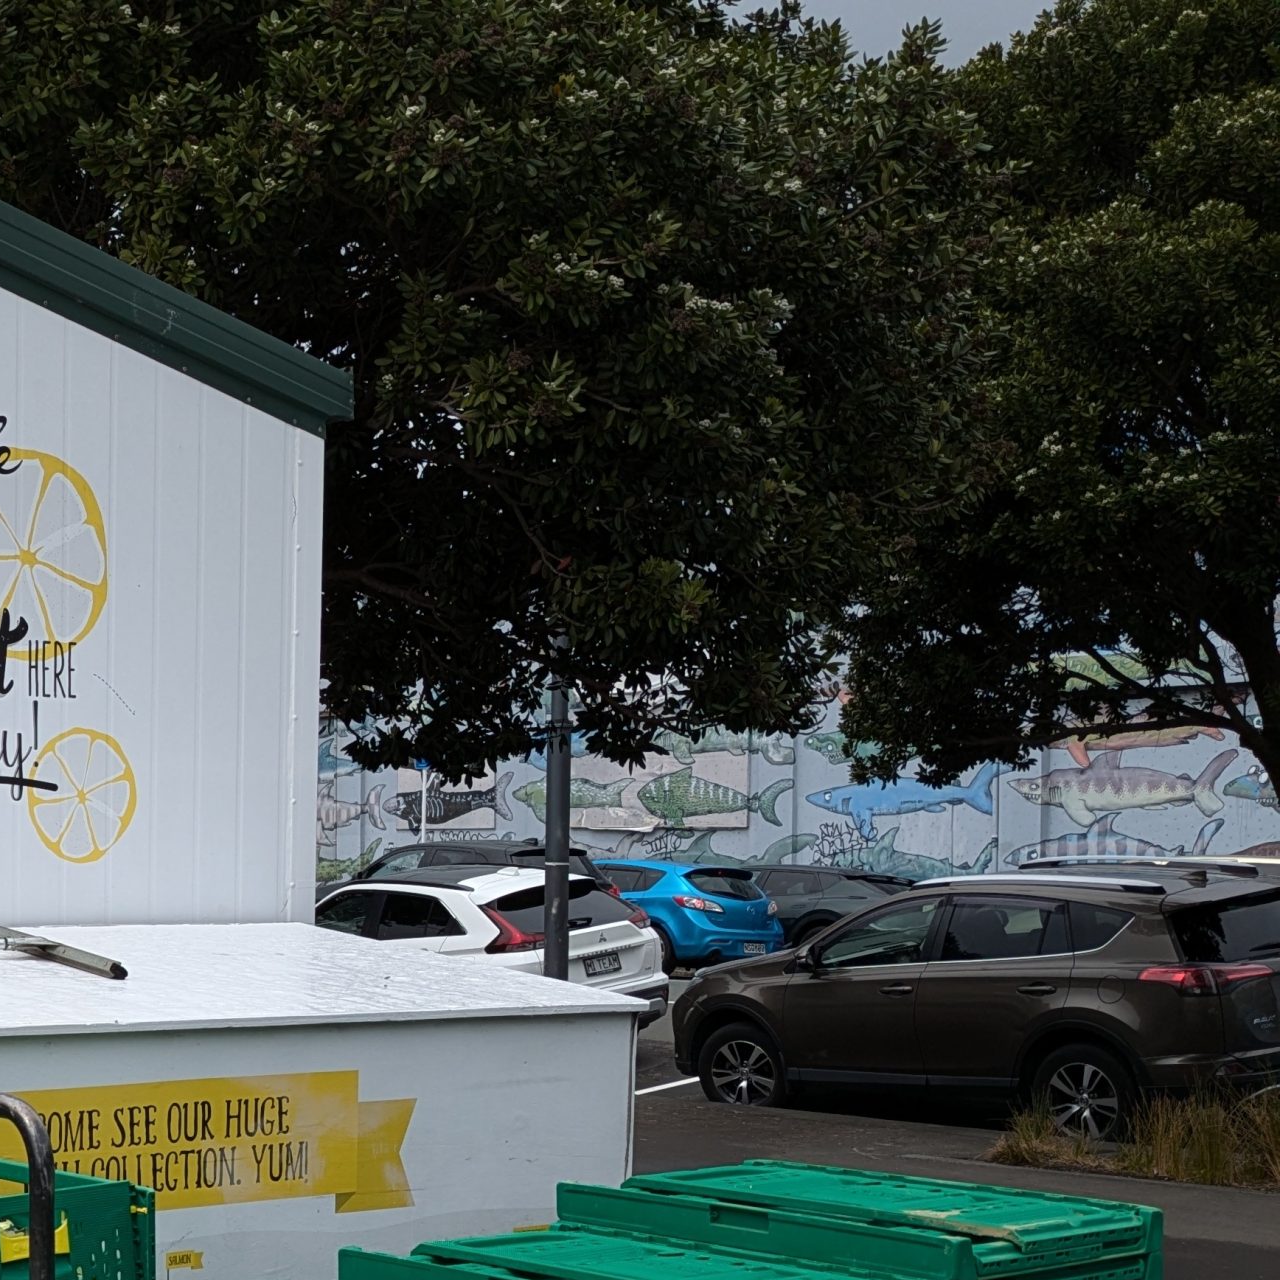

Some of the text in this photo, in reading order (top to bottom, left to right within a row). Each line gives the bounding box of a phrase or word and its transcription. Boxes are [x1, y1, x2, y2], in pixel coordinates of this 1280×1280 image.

[28, 641, 78, 699] HERE
[111, 1104, 158, 1148] SEE
[167, 1100, 215, 1144] OUR
[224, 1096, 290, 1139] HUGE
[251, 1141, 309, 1184] YUM!
[168, 1253, 192, 1266] SALMON
